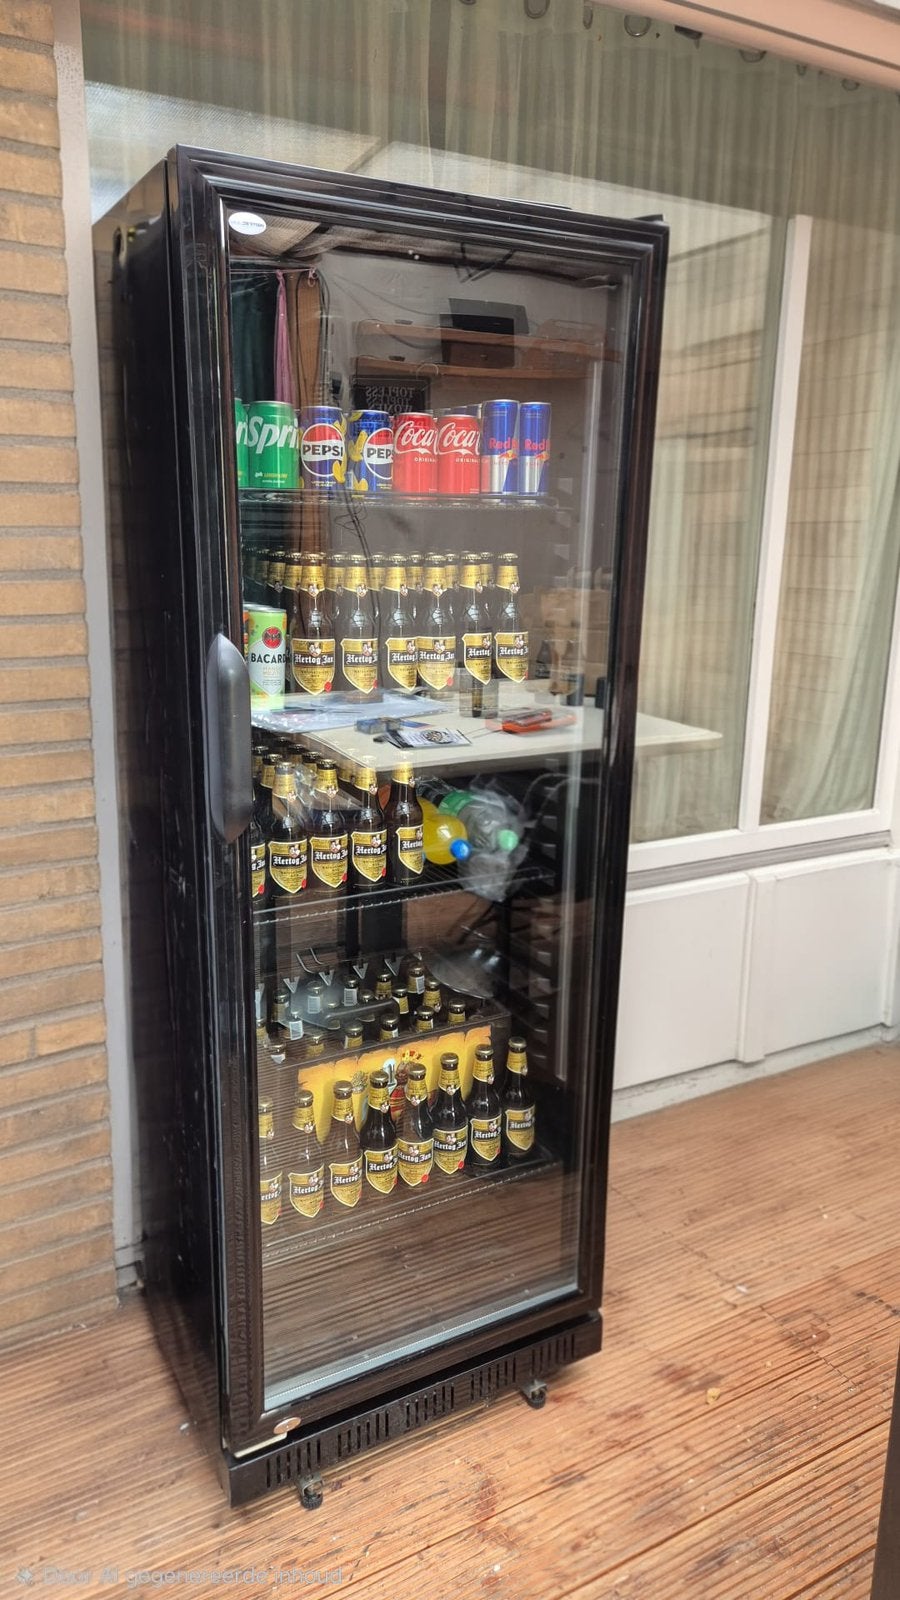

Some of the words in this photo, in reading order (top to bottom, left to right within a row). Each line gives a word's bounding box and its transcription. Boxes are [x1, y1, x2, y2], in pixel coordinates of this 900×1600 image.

[247, 416, 299, 454] Spri
[489, 437, 511, 450] Red
[525, 439, 546, 451] Red
[303, 444, 343, 456] PEPSI
[366, 447, 393, 459] PEP
[419, 652, 446, 661] Hertog
[499, 647, 524, 656] Hertog
[294, 654, 321, 665] Hertog
[346, 654, 373, 664] Hertog
[355, 845, 381, 856] Hertog
[273, 856, 300, 866] Hertog
[314, 851, 341, 862] Hertog
[474, 1129, 498, 1139] Hertog
[434, 1141, 456, 1151] Hertog
[369, 1162, 393, 1172] Hertog
[334, 1174, 359, 1185] Hertog
[293, 1184, 319, 1195] Hertog
[261, 1190, 280, 1201] ertog
